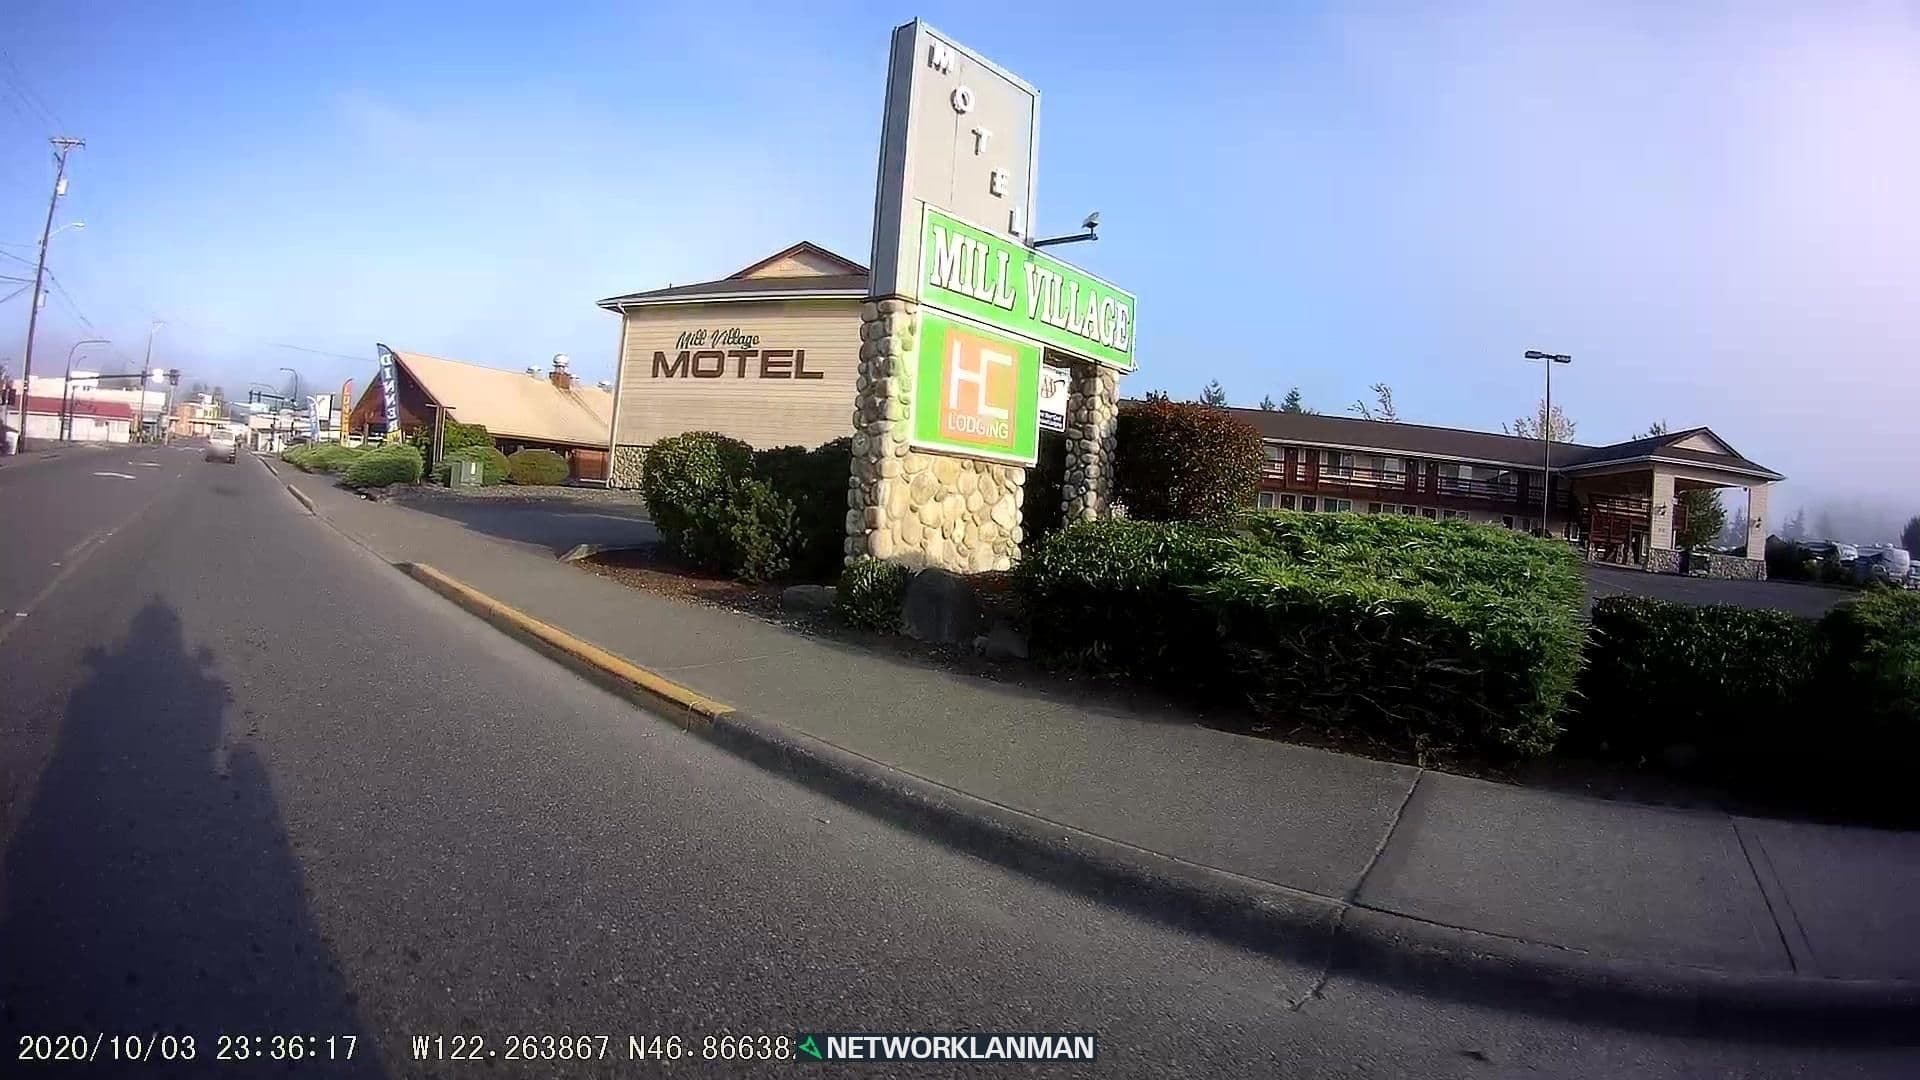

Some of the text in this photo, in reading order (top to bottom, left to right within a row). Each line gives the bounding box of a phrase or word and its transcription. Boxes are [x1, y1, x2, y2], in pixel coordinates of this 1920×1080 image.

[928, 39, 1026, 239] MOTEL
[930, 224, 1131, 353] MILL VILLAGE
[676, 327, 760, 350] Mill Village
[651, 349, 824, 379] MOTEL
[948, 411, 1009, 440] LODGING
